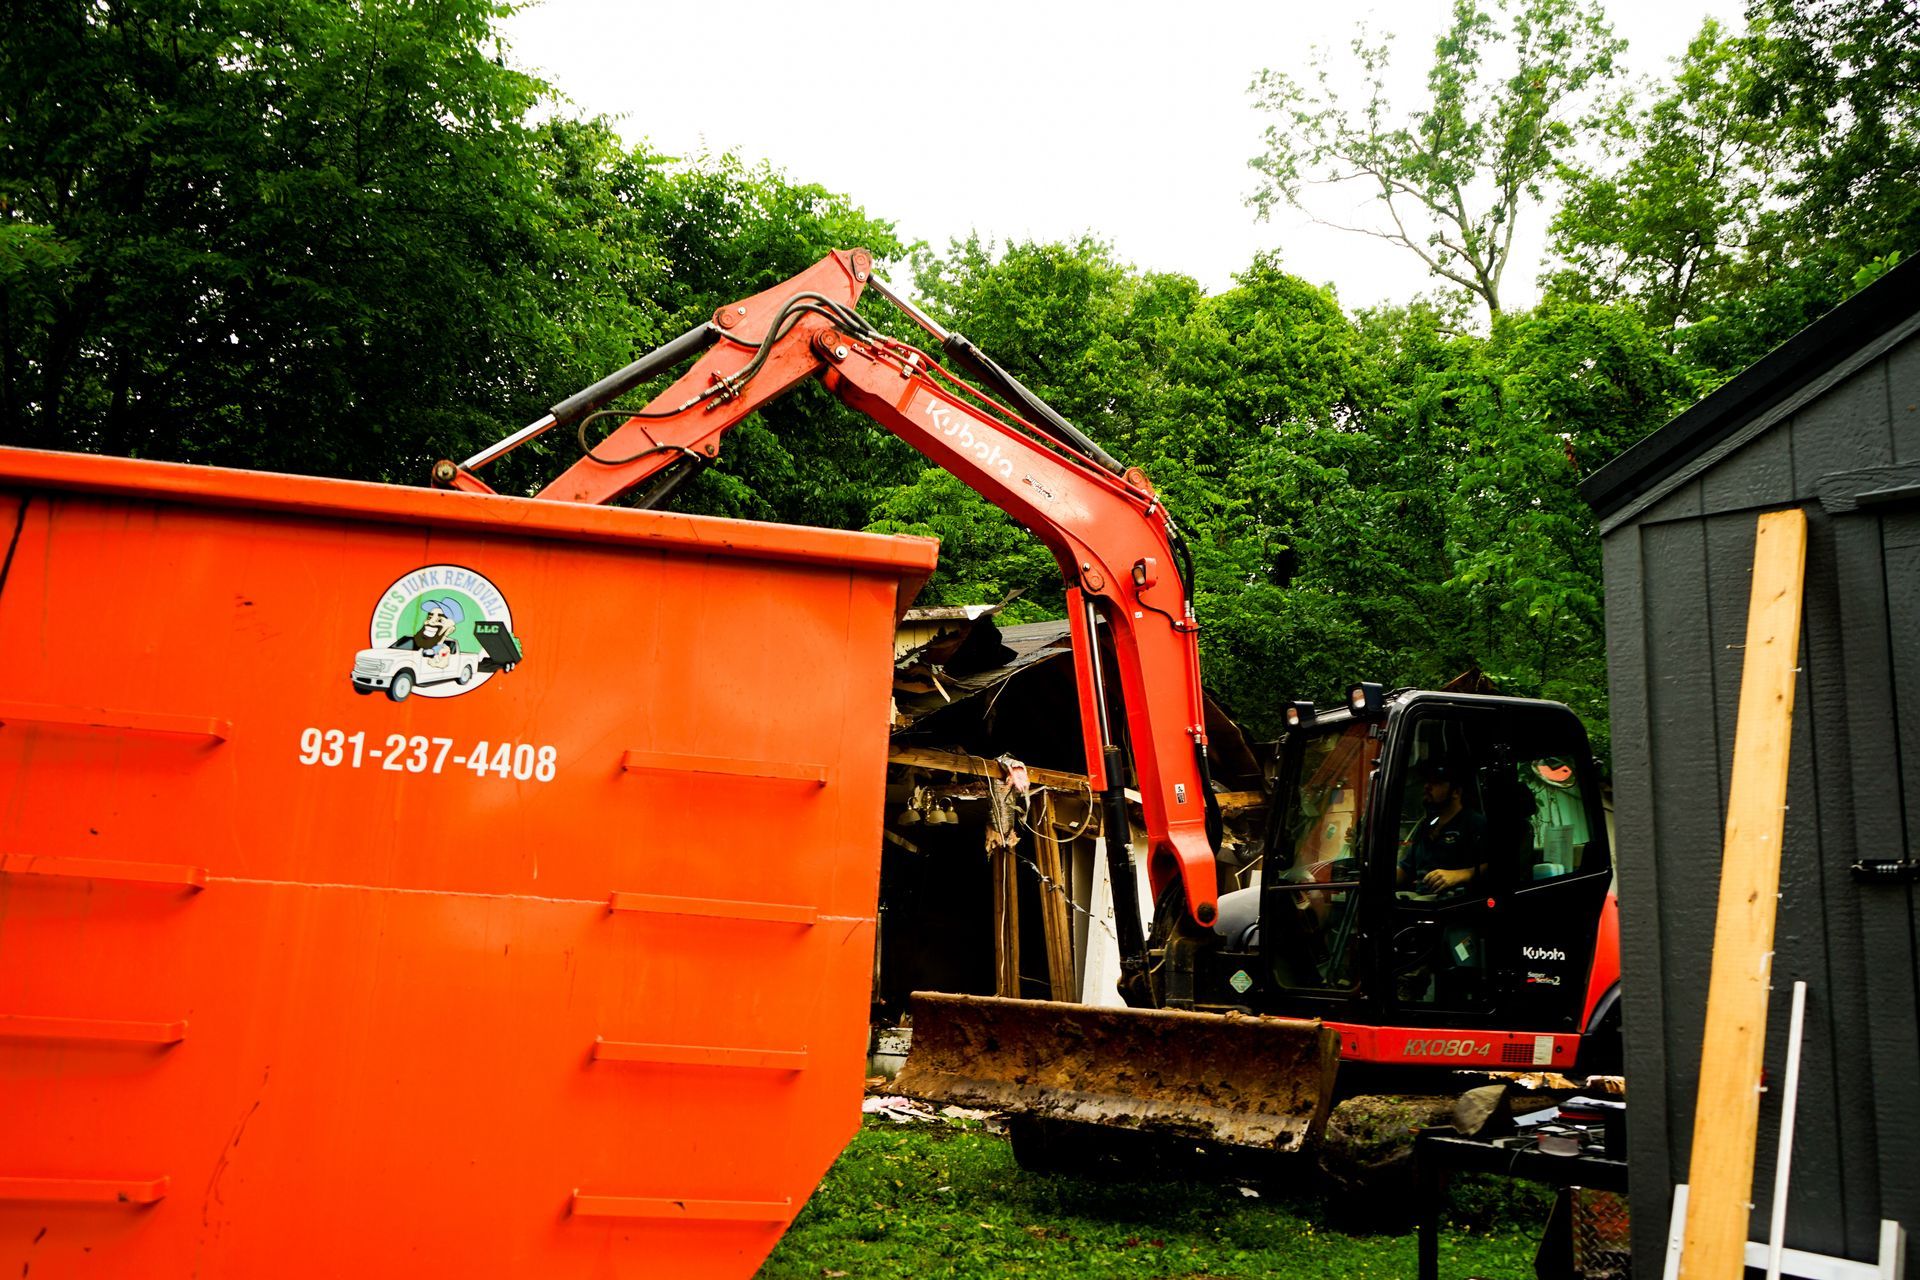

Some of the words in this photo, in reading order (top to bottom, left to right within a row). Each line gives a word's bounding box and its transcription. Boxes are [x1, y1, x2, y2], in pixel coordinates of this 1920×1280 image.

[925, 399, 1014, 478] Kubota
[375, 590, 406, 640] DOUG'S
[402, 570, 438, 596] JUNK
[445, 569, 503, 617] REMOVAL
[476, 624, 499, 634] LLC
[299, 727, 557, 782] 931-237-4408
[1522, 946, 1566, 961] Kubota
